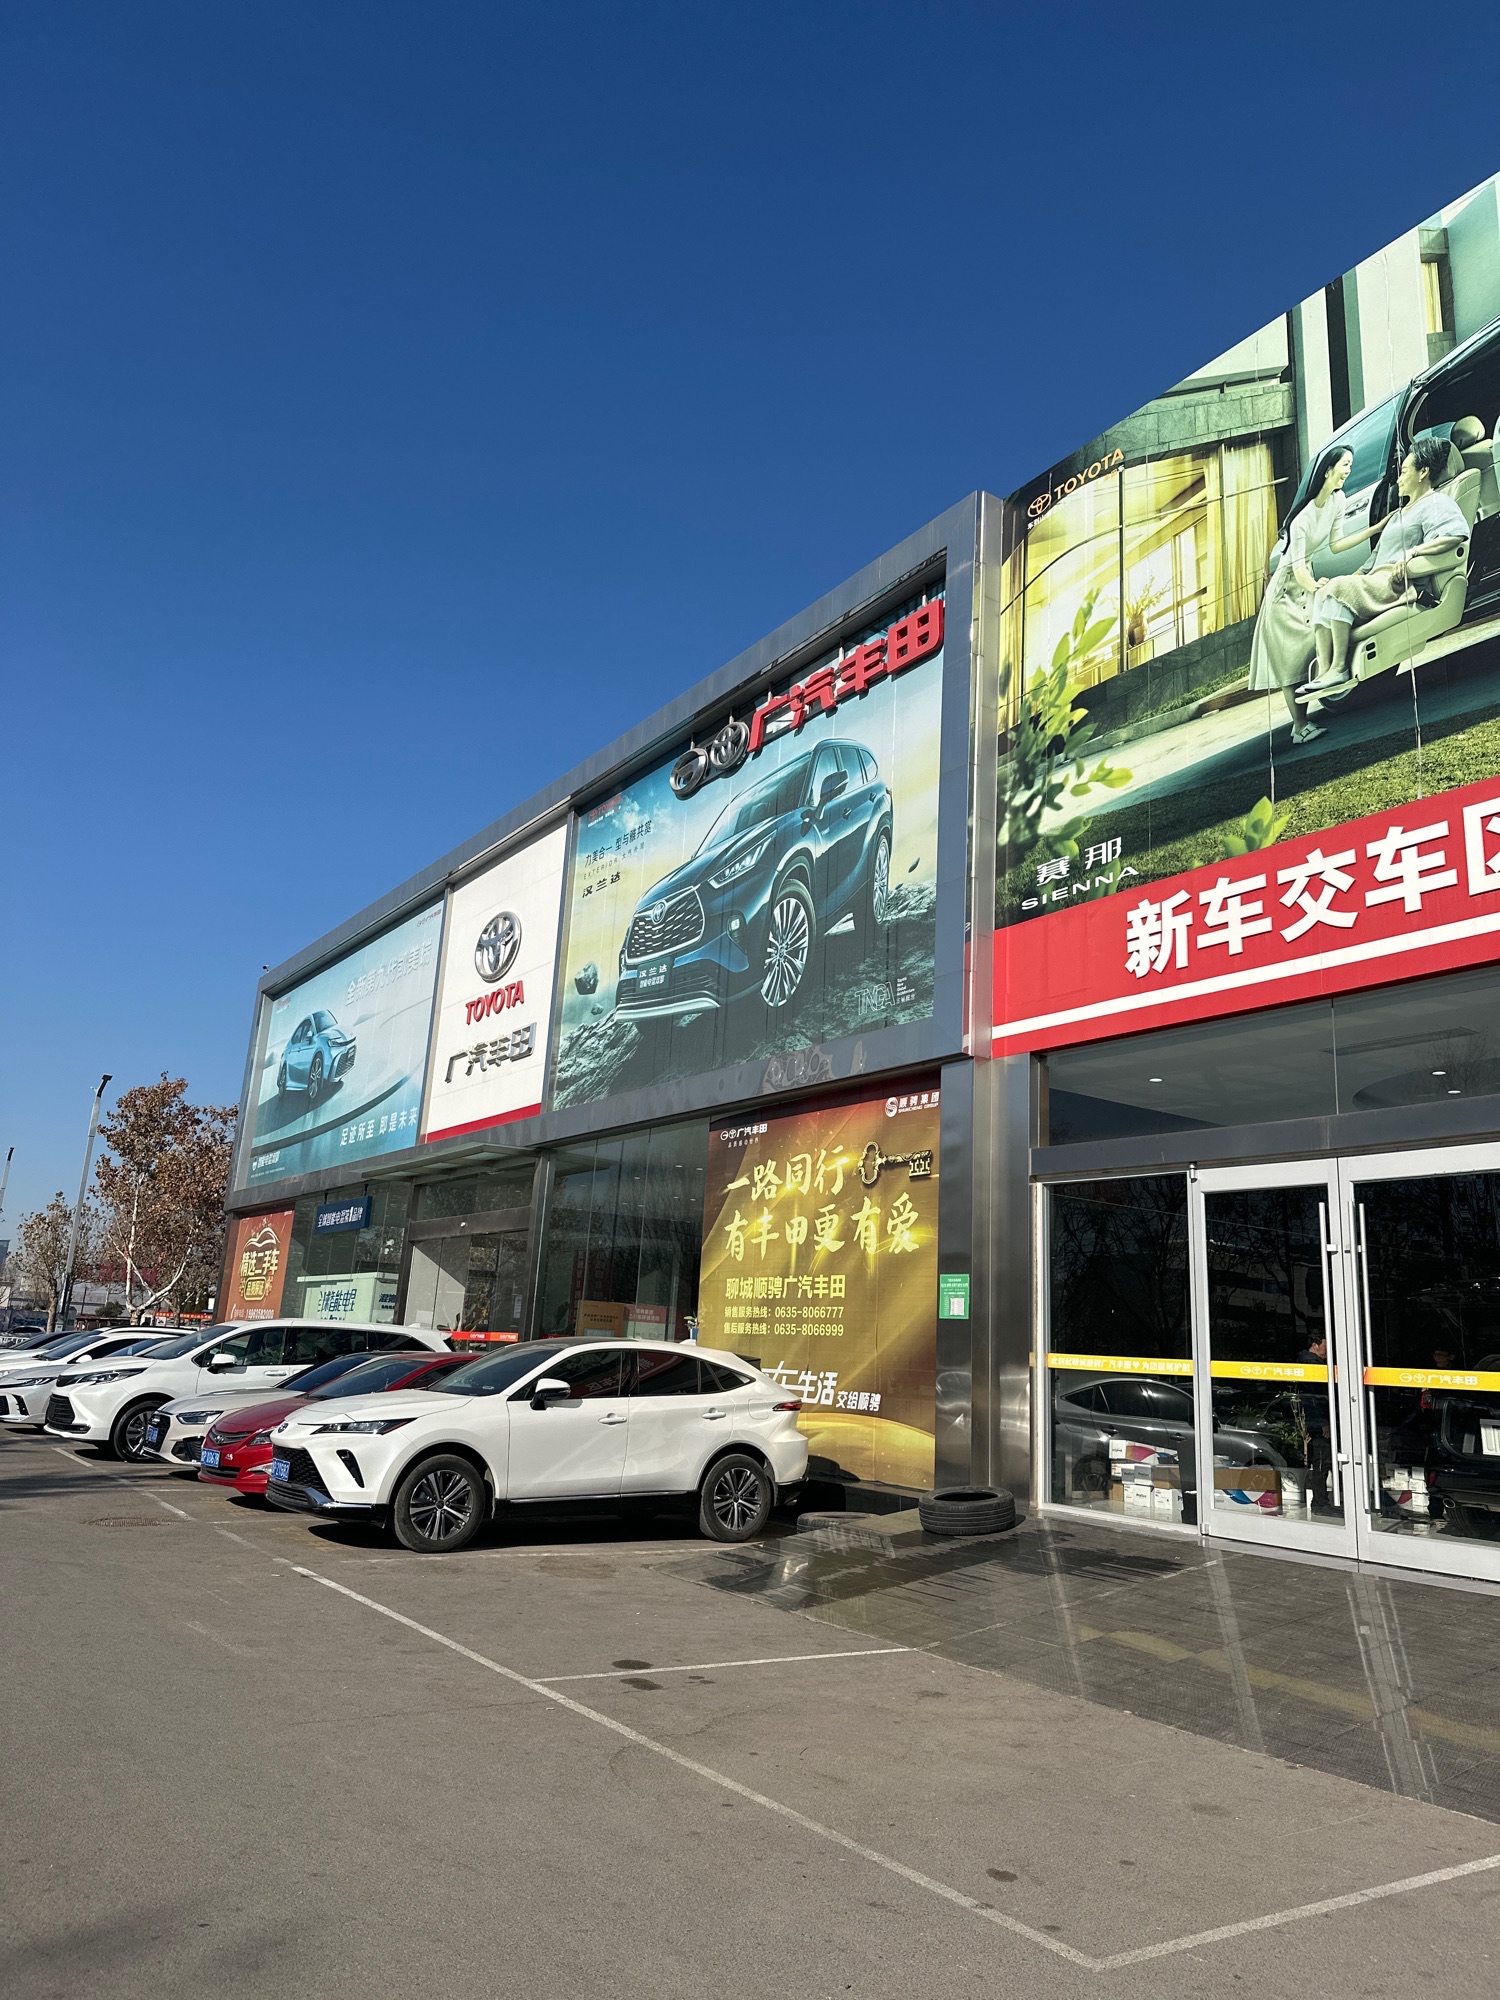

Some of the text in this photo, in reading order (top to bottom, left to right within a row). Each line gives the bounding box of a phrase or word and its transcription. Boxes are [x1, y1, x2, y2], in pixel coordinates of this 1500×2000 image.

[1054, 448, 1125, 500] TOYOTA
[748, 599, 944, 752] 广汽丰田
[1037, 837, 1121, 886] 赛那
[582, 871, 621, 898] 汉兰达
[1021, 866, 1139, 910] SIENNA
[638, 964, 667, 978] 汉兰达
[466, 980, 525, 1025] TOYOTA
[444, 1022, 537, 1083] 广汽丰田
[379, 1106, 418, 1135] 即是未来
[737, 1123, 768, 1138] 广汽丰田
[727, 1145, 849, 1202] 一路同行
[724, 1192, 919, 1261] 有丰田更有爱
[240, 1248, 280, 1277] 精选二手车
[1263, 1366, 1305, 1378] 广汽丰田
[1427, 1374, 1478, 1386] 广汽丰田
